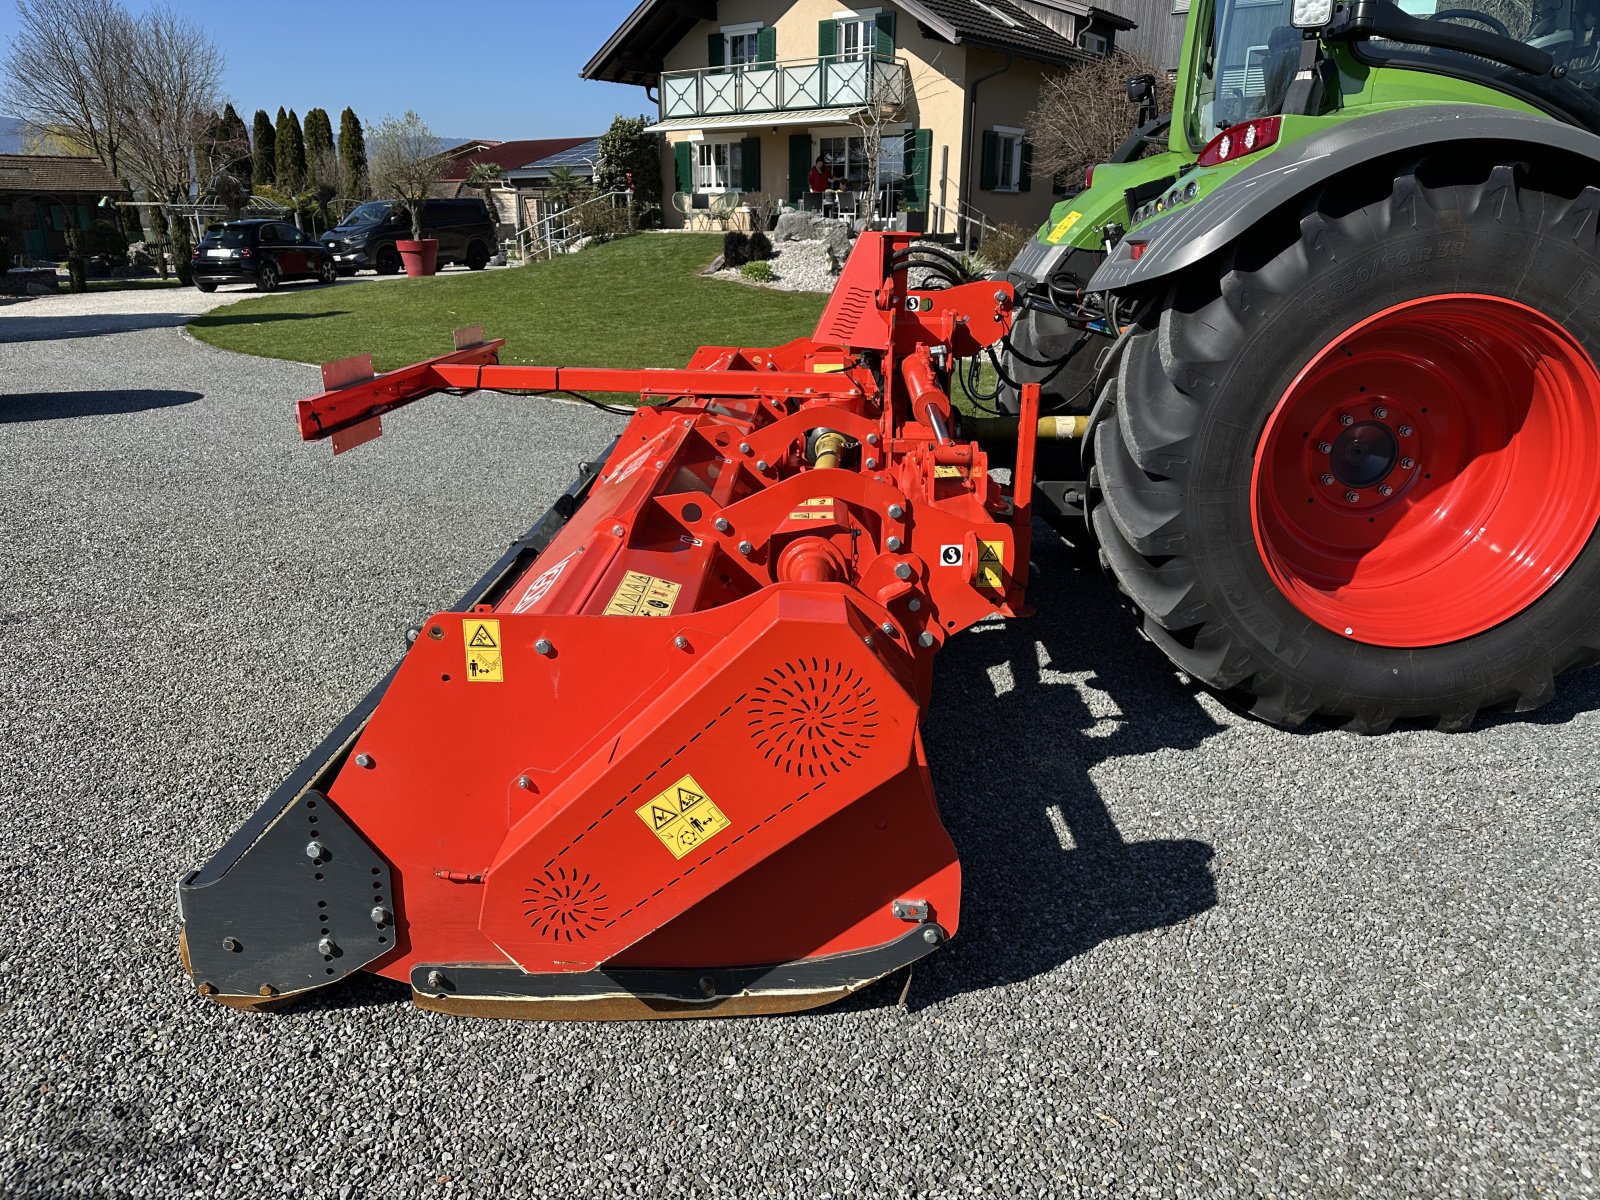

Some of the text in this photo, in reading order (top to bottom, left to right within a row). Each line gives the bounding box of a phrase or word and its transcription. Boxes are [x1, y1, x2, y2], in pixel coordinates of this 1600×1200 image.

[1328, 248, 1412, 300] 650/60
[1415, 246, 1433, 264] R
[1436, 239, 1467, 258] 38
